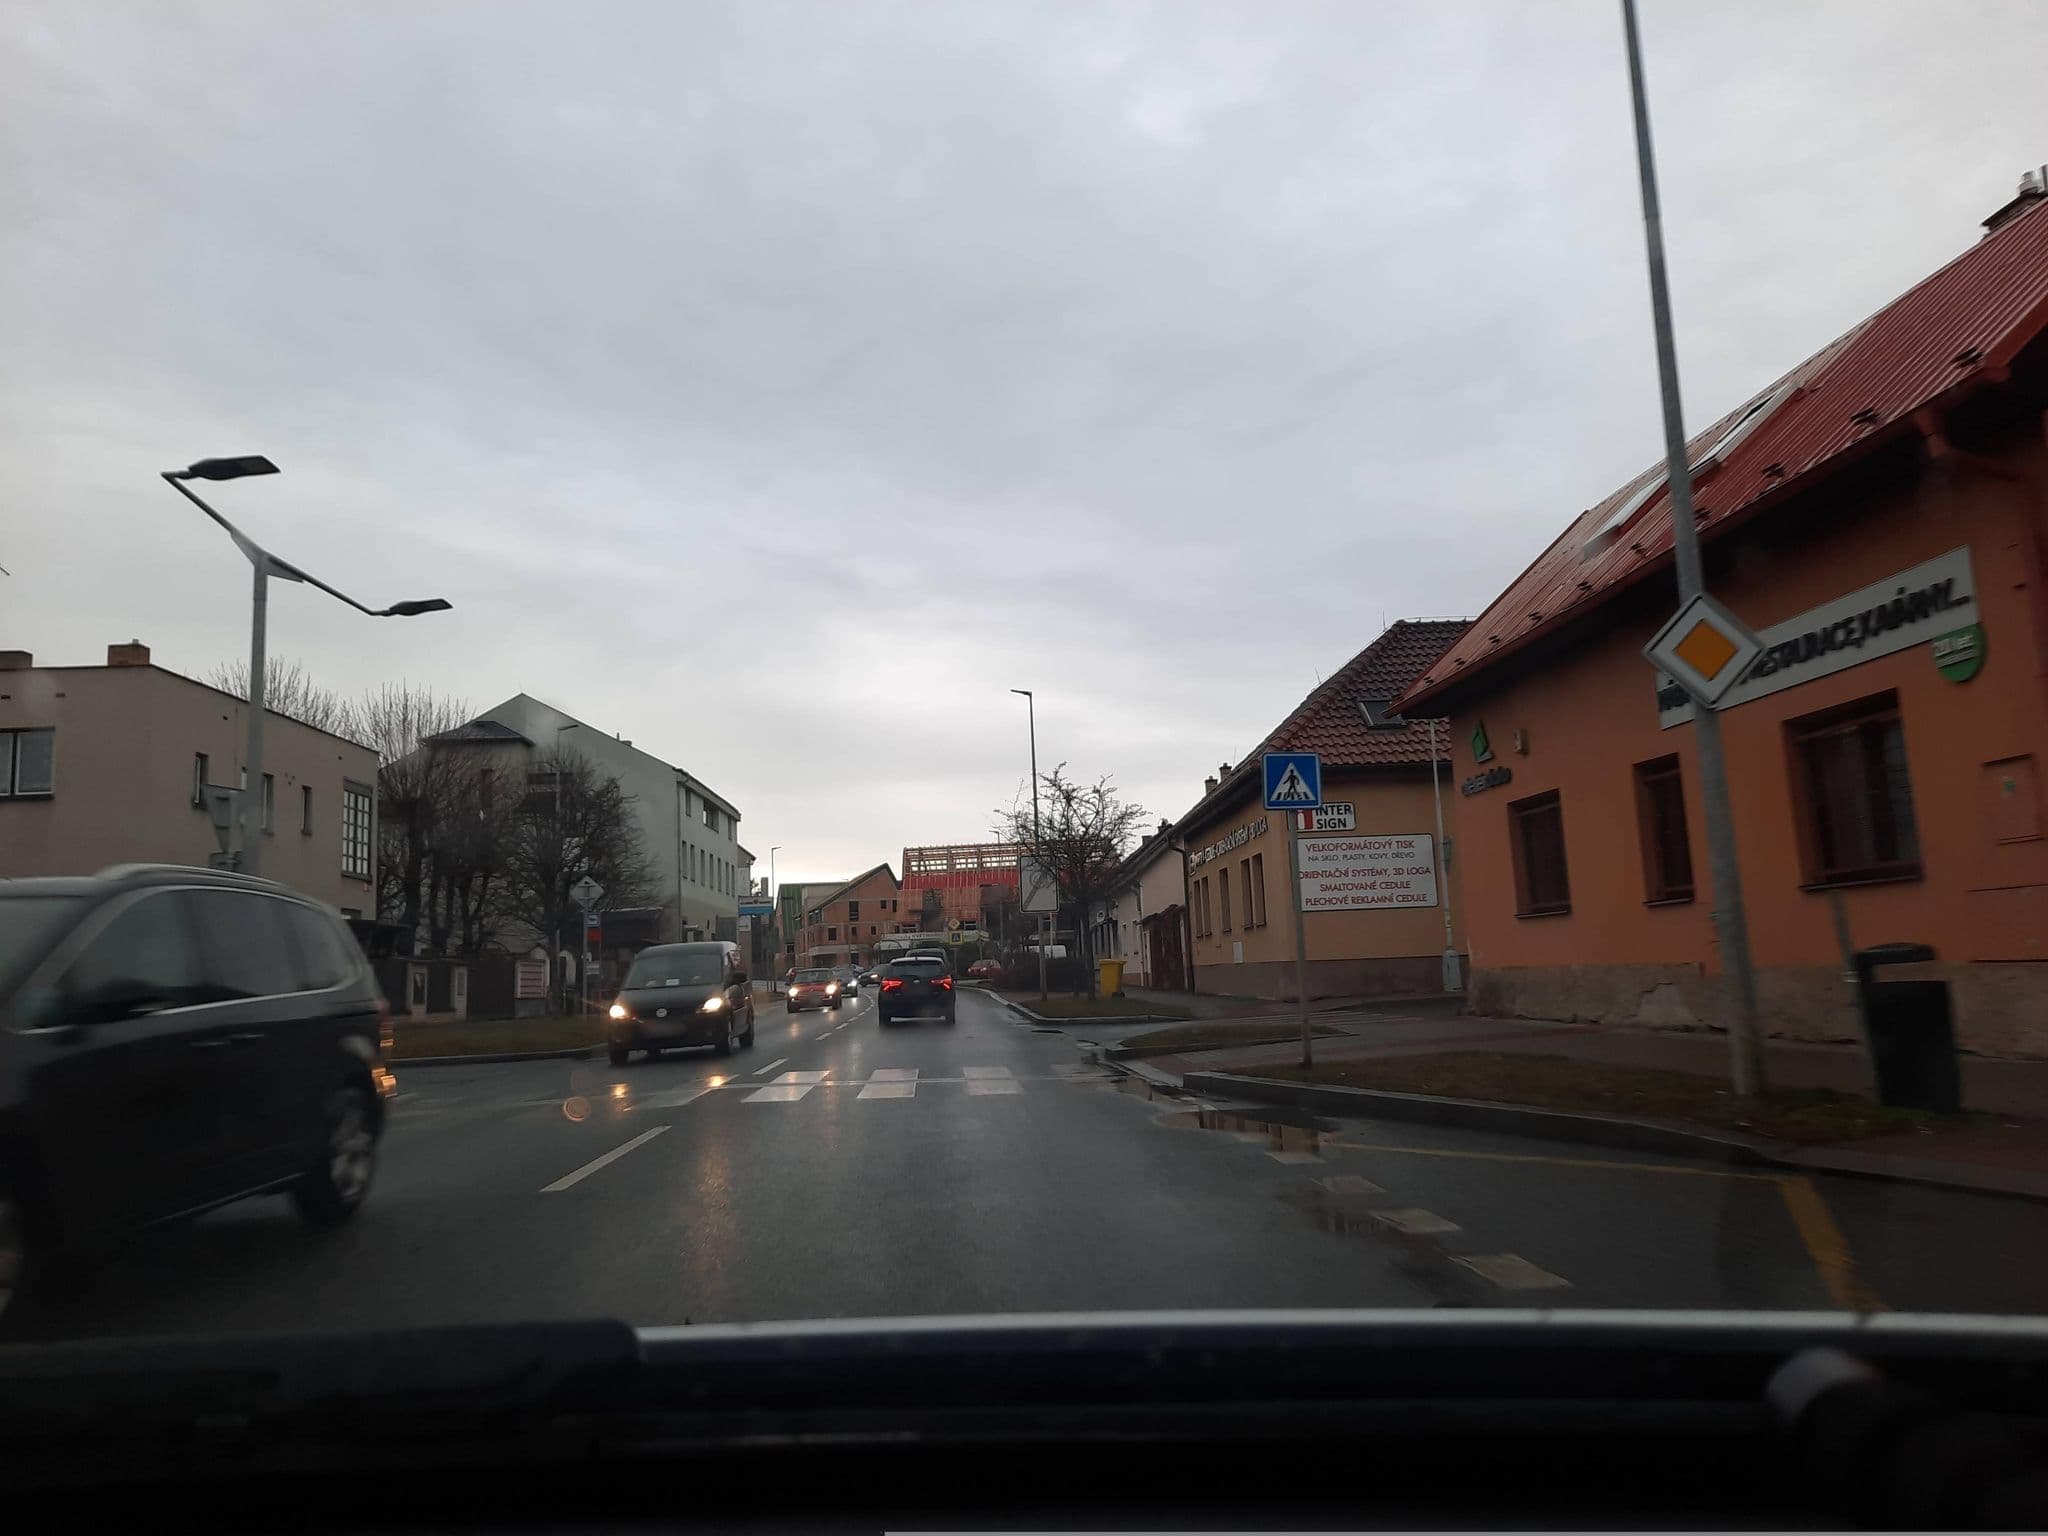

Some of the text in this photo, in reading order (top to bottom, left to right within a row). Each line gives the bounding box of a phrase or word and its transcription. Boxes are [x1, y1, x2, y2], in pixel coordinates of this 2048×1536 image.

[1315, 804, 1352, 816] INTER
[1316, 817, 1347, 829] SIGN
[1305, 839, 1415, 852] VELKOFORMÁTOVÝ TISK
[1298, 868, 1349, 879] ORIENTAČNÍ
[1393, 868, 1404, 876] 3D
[1406, 866, 1431, 875] LOGA
[1320, 880, 1411, 892] SMALTOVANÉ CEDULE
[1305, 893, 1428, 906] PLECHOVÉ REKLAMNÍ CEDULE
